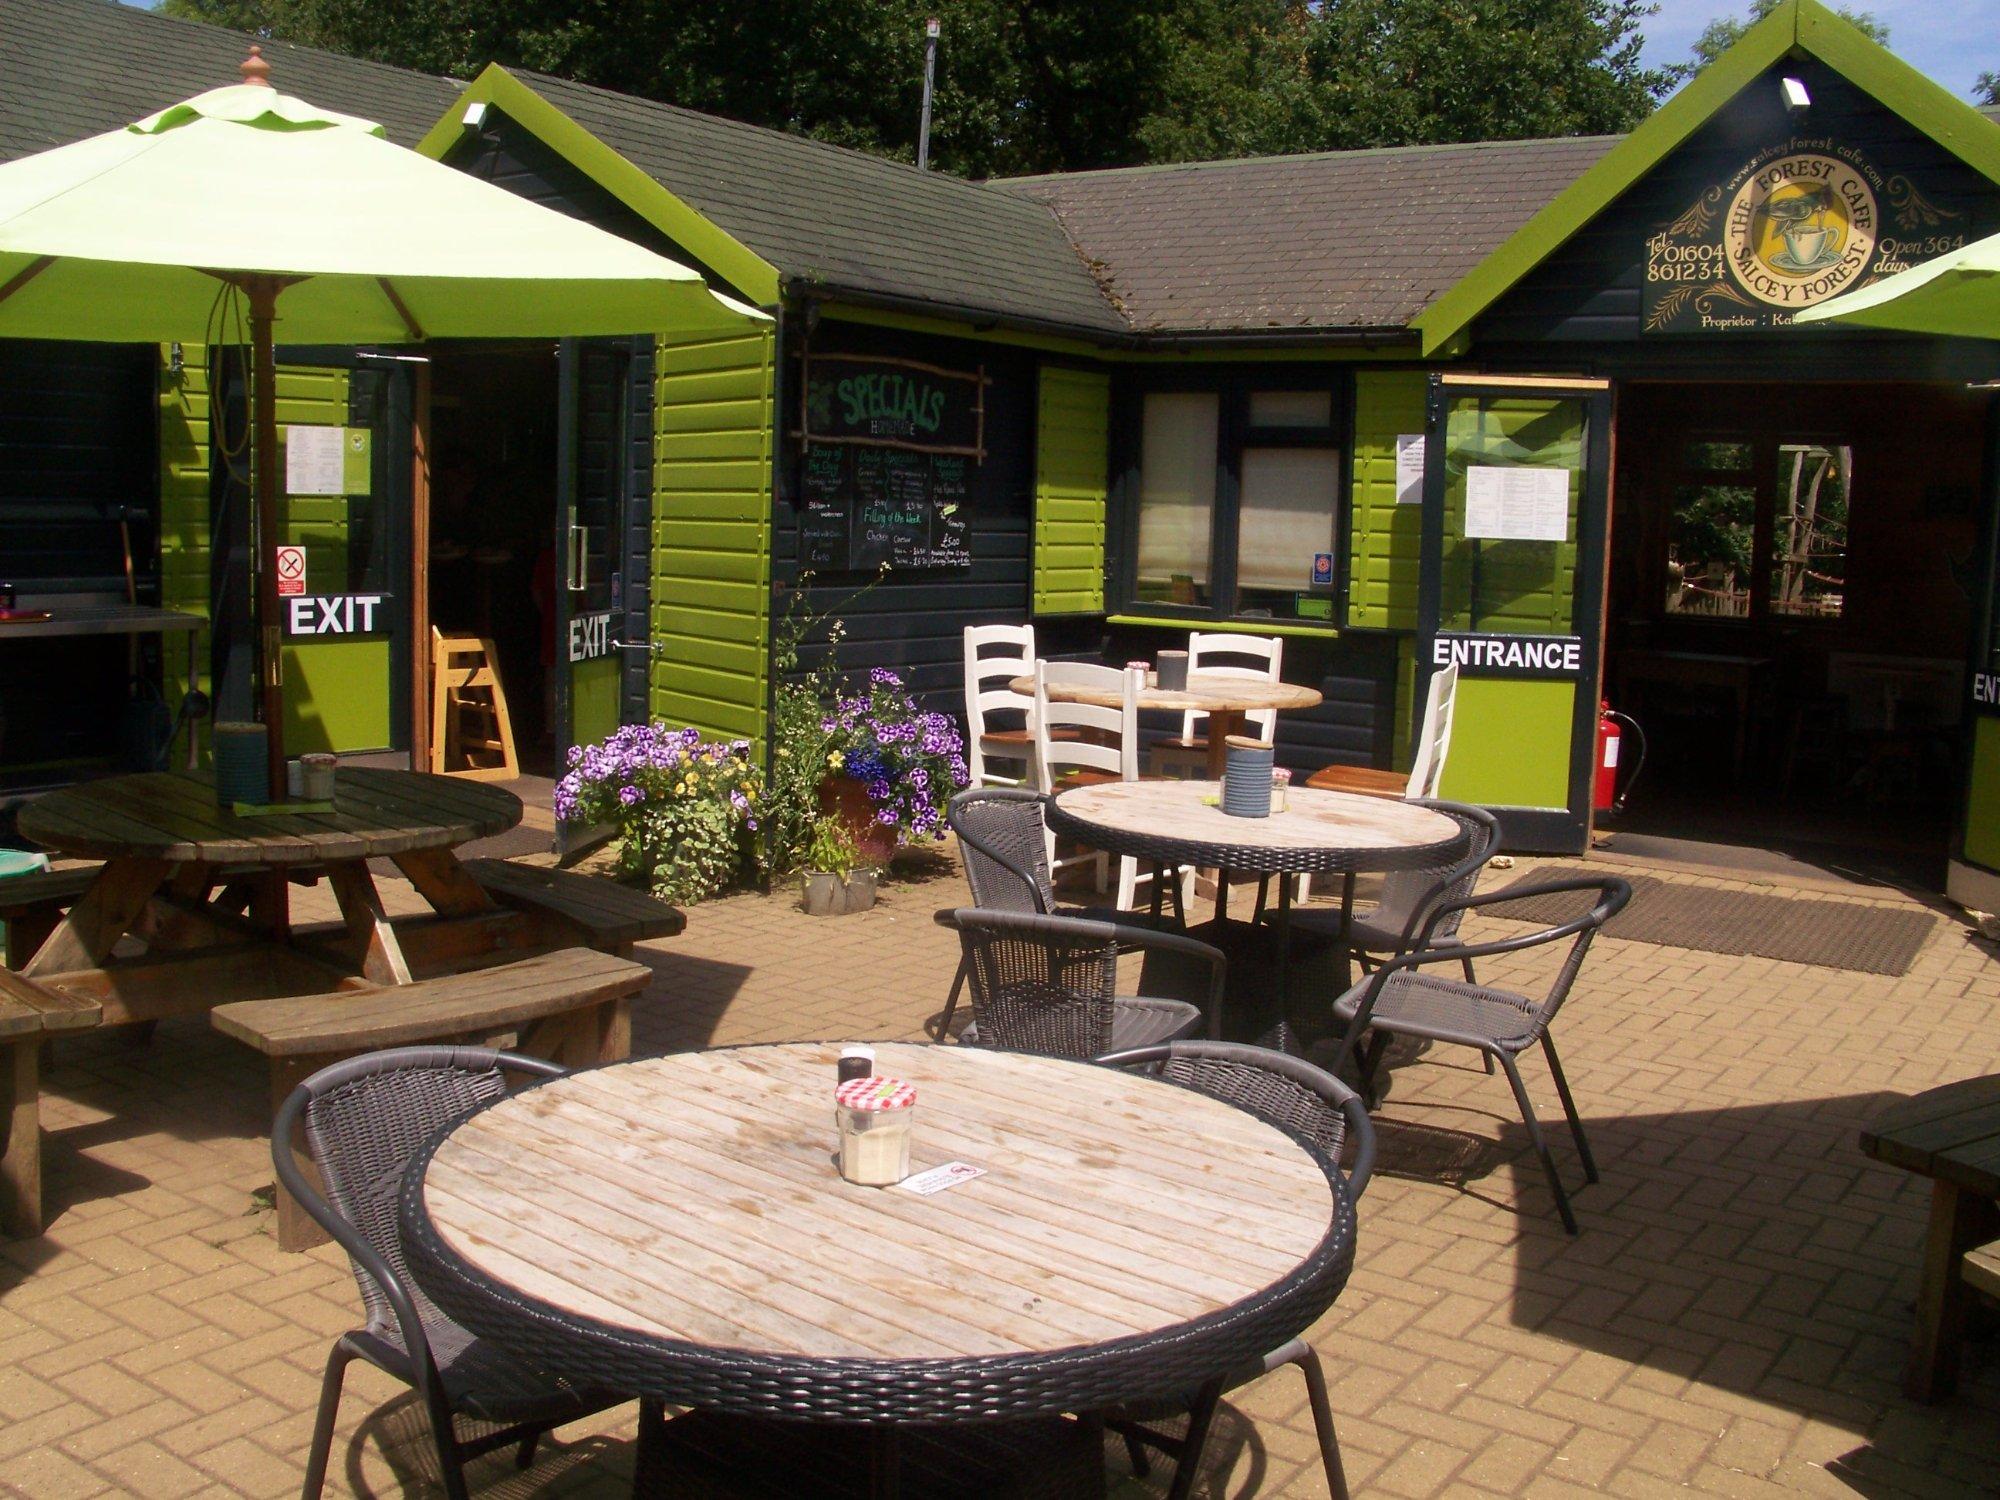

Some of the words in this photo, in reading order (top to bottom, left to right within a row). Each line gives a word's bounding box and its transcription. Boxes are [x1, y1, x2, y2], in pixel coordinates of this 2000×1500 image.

[1731, 199, 1754, 238] THE
[1755, 159, 1836, 193] FOREST
[1841, 179, 1872, 230] CAFE
[1663, 243, 1725, 262] 01604
[1878, 237, 1922, 256] Open
[1924, 234, 1966, 253] 364
[1647, 261, 1727, 283] 861234
[1733, 247, 1799, 302] SALCEY
[1800, 245, 1867, 302] FOREST
[1701, 314, 1757, 331] Proprietor
[838, 373, 945, 432] SPECIALS
[290, 596, 381, 635] EXIT
[569, 614, 610, 662] EXIT
[1433, 638, 1581, 670] ENTRANCE
